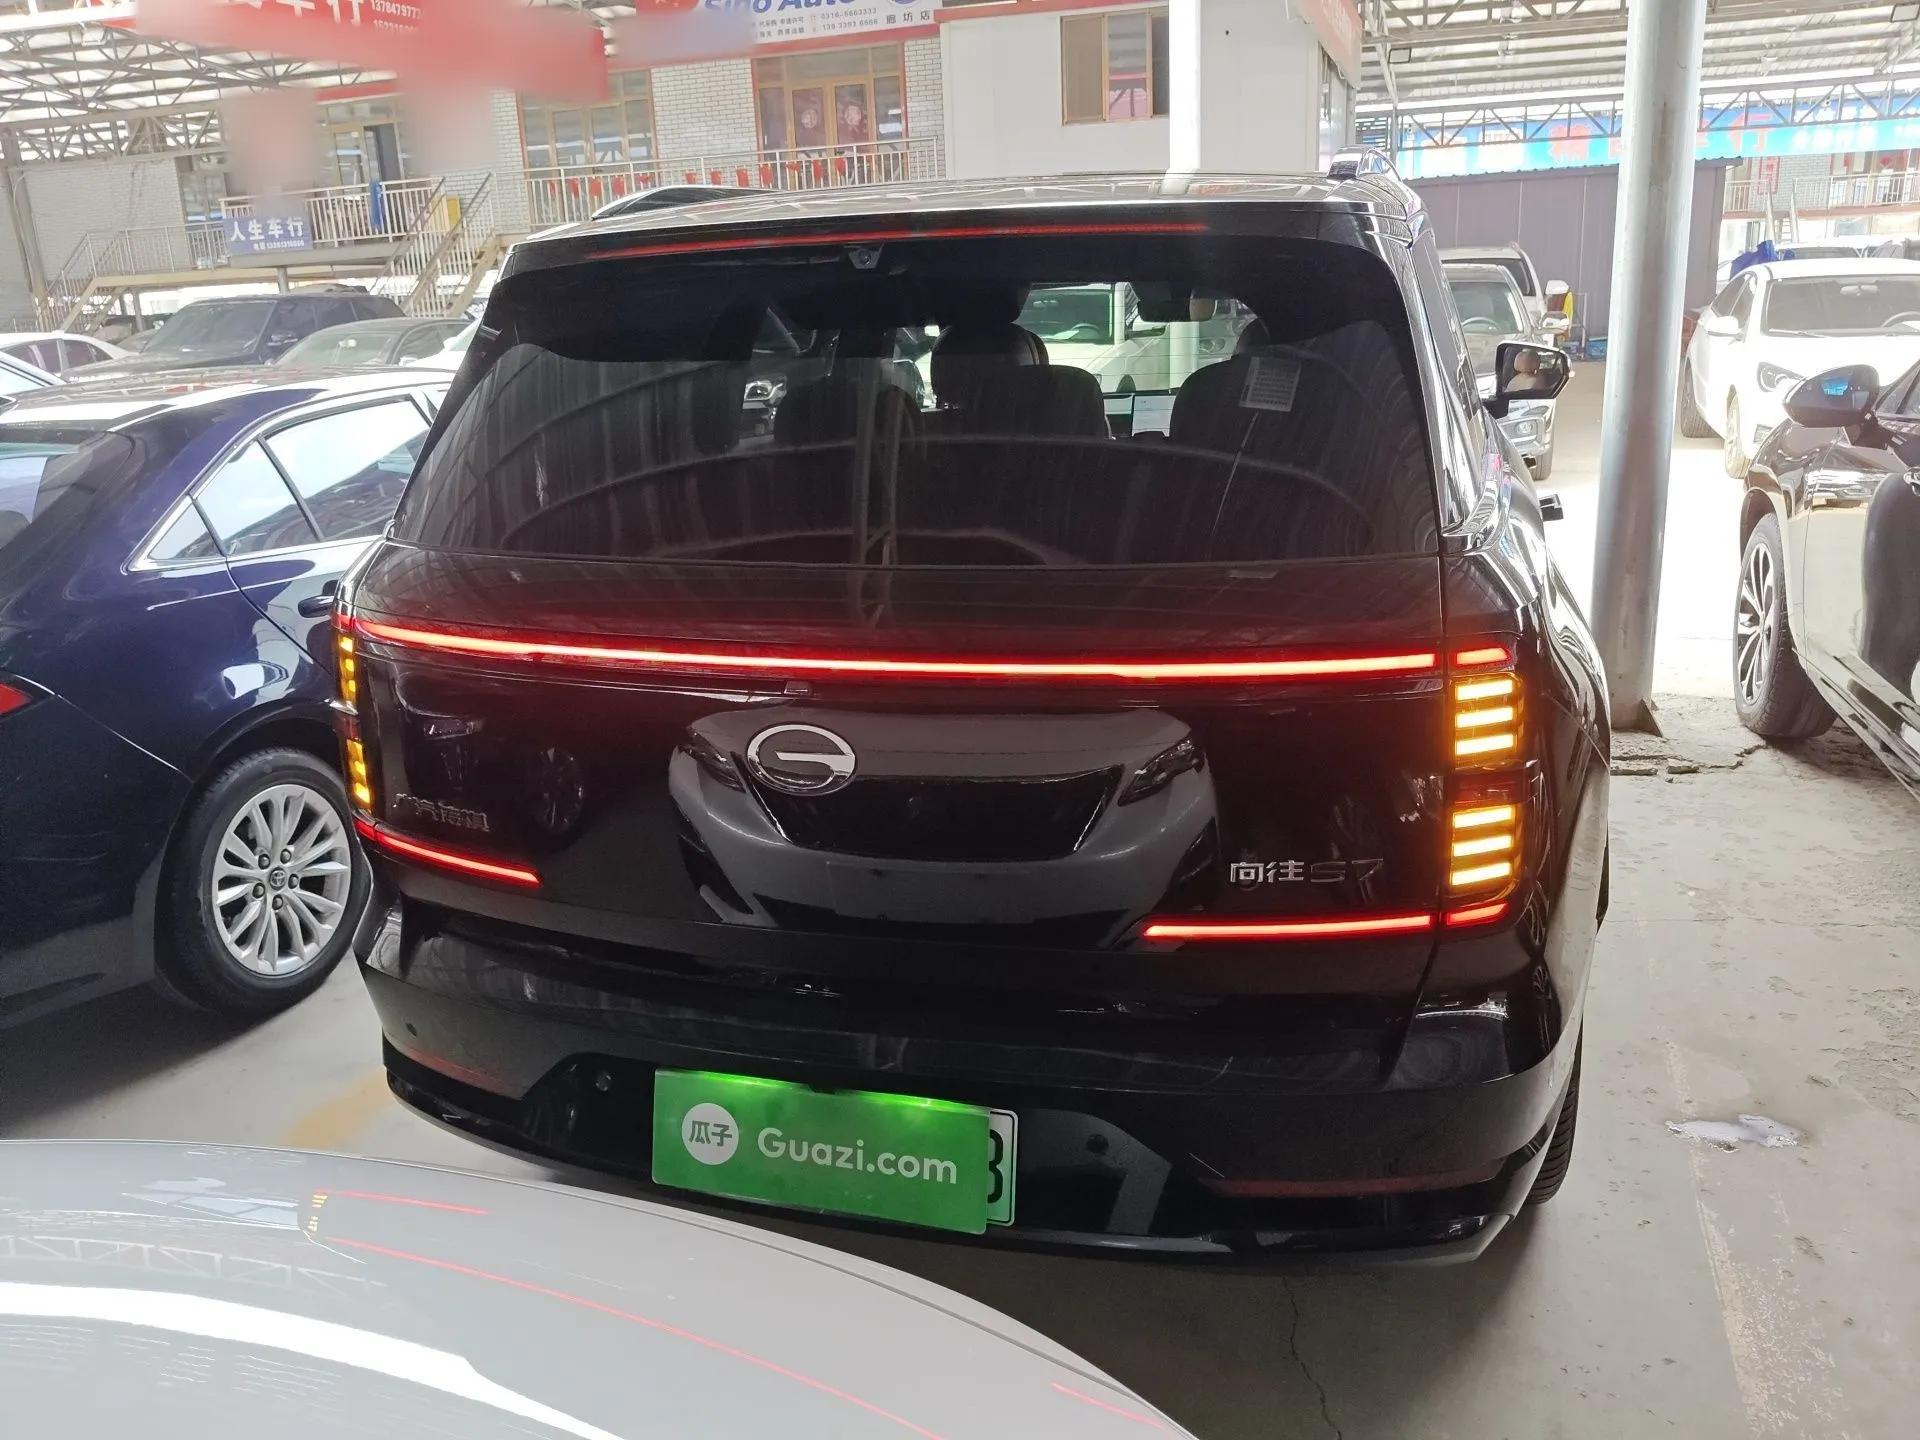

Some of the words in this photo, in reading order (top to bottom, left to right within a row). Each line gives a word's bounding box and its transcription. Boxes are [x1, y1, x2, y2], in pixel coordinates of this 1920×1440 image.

[230, 217, 304, 243] 人生车行
[687, 1120, 733, 1147] 瓜子
[757, 1127, 958, 1185] Guazi.com
